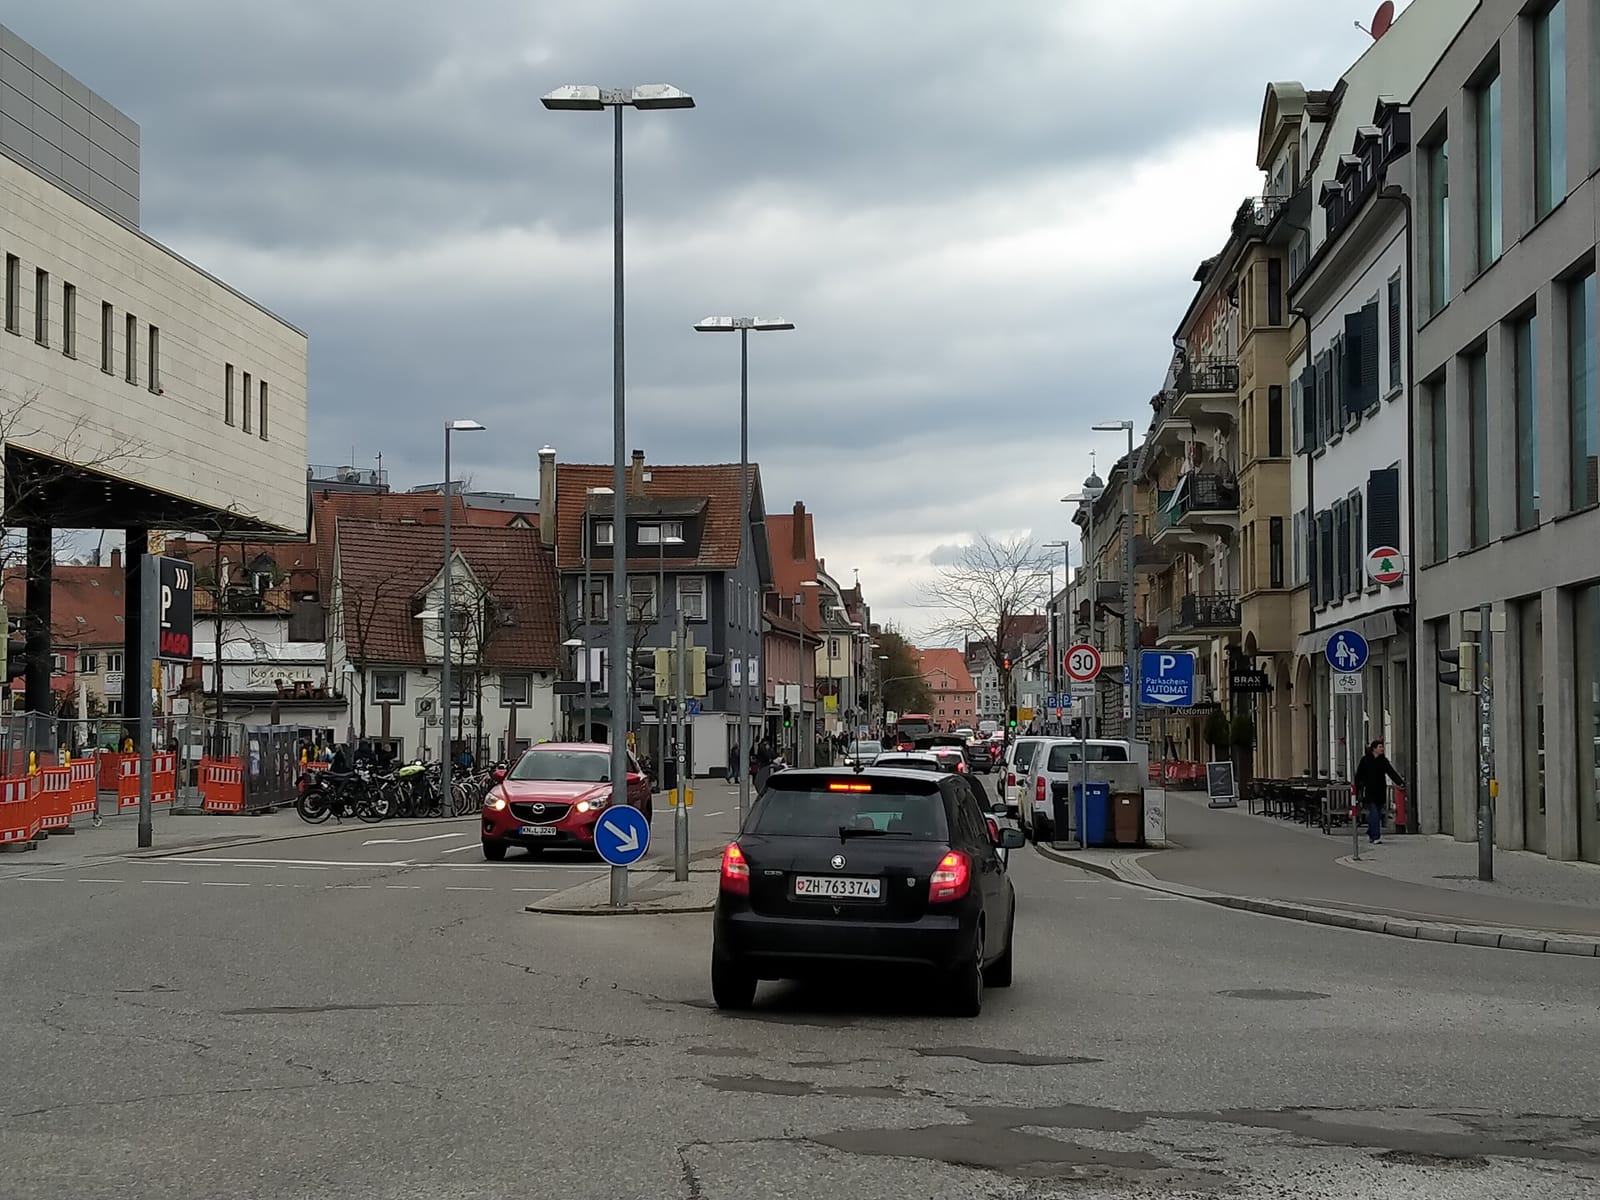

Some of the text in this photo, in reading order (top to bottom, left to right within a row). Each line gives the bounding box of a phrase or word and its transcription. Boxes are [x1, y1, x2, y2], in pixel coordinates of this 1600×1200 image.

[161, 584, 172, 622] P
[161, 630, 190, 655] LAGO
[1072, 654, 1094, 671] 30
[1159, 655, 1176, 677] P
[250, 667, 313, 679] Kosmetik
[1233, 675, 1261, 684] BRAX
[1145, 677, 1189, 686] Parkschein-
[1145, 685, 1189, 694] AUTOMAT
